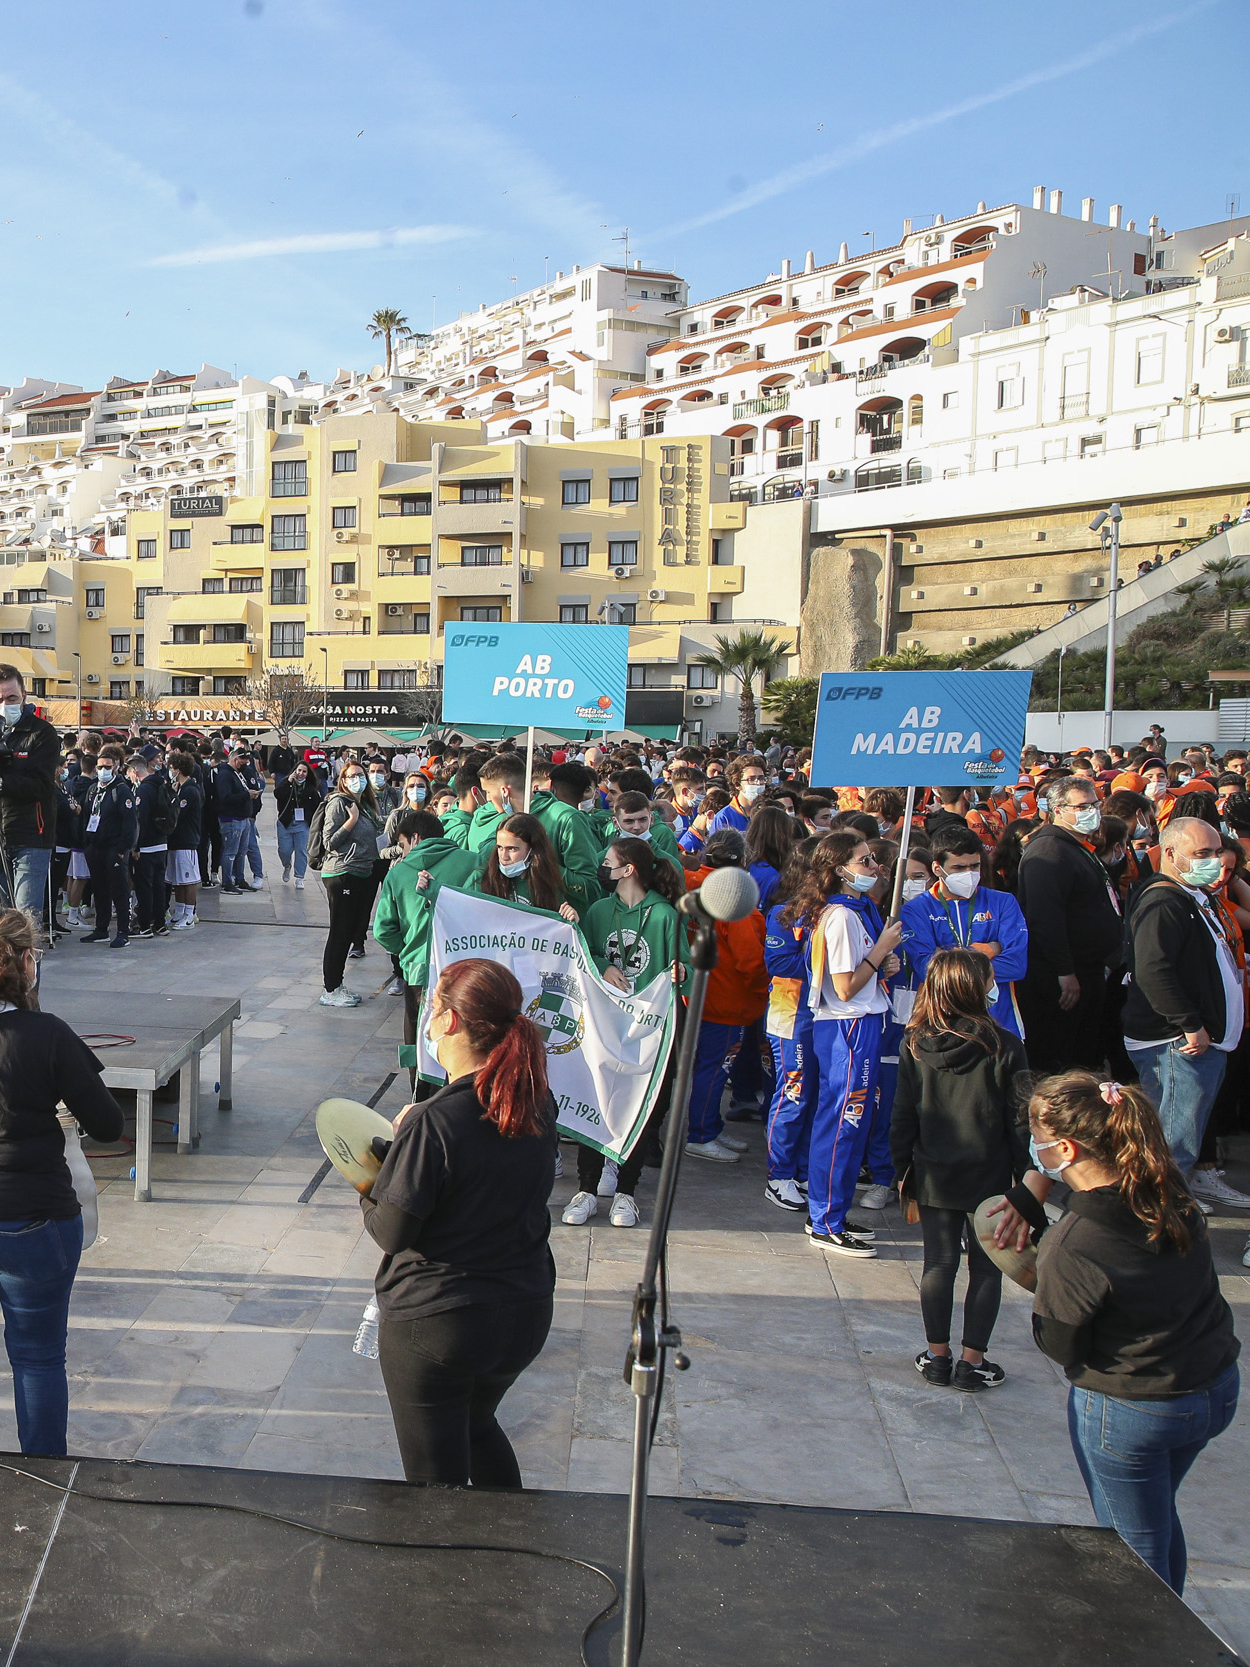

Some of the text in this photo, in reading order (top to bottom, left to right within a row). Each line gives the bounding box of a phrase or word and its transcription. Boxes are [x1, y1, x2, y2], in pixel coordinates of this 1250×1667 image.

[173, 498, 220, 509] TURIAL
[658, 445, 677, 566] TURIAL
[515, 654, 553, 675] AB
[492, 676, 576, 699] PORTO
[899, 706, 942, 729] AB
[850, 731, 982, 755] MADEIRA
[963, 761, 988, 769] Festa
[444, 931, 526, 954] ASSOCIAÇÃO
[531, 937, 549, 952] DE
